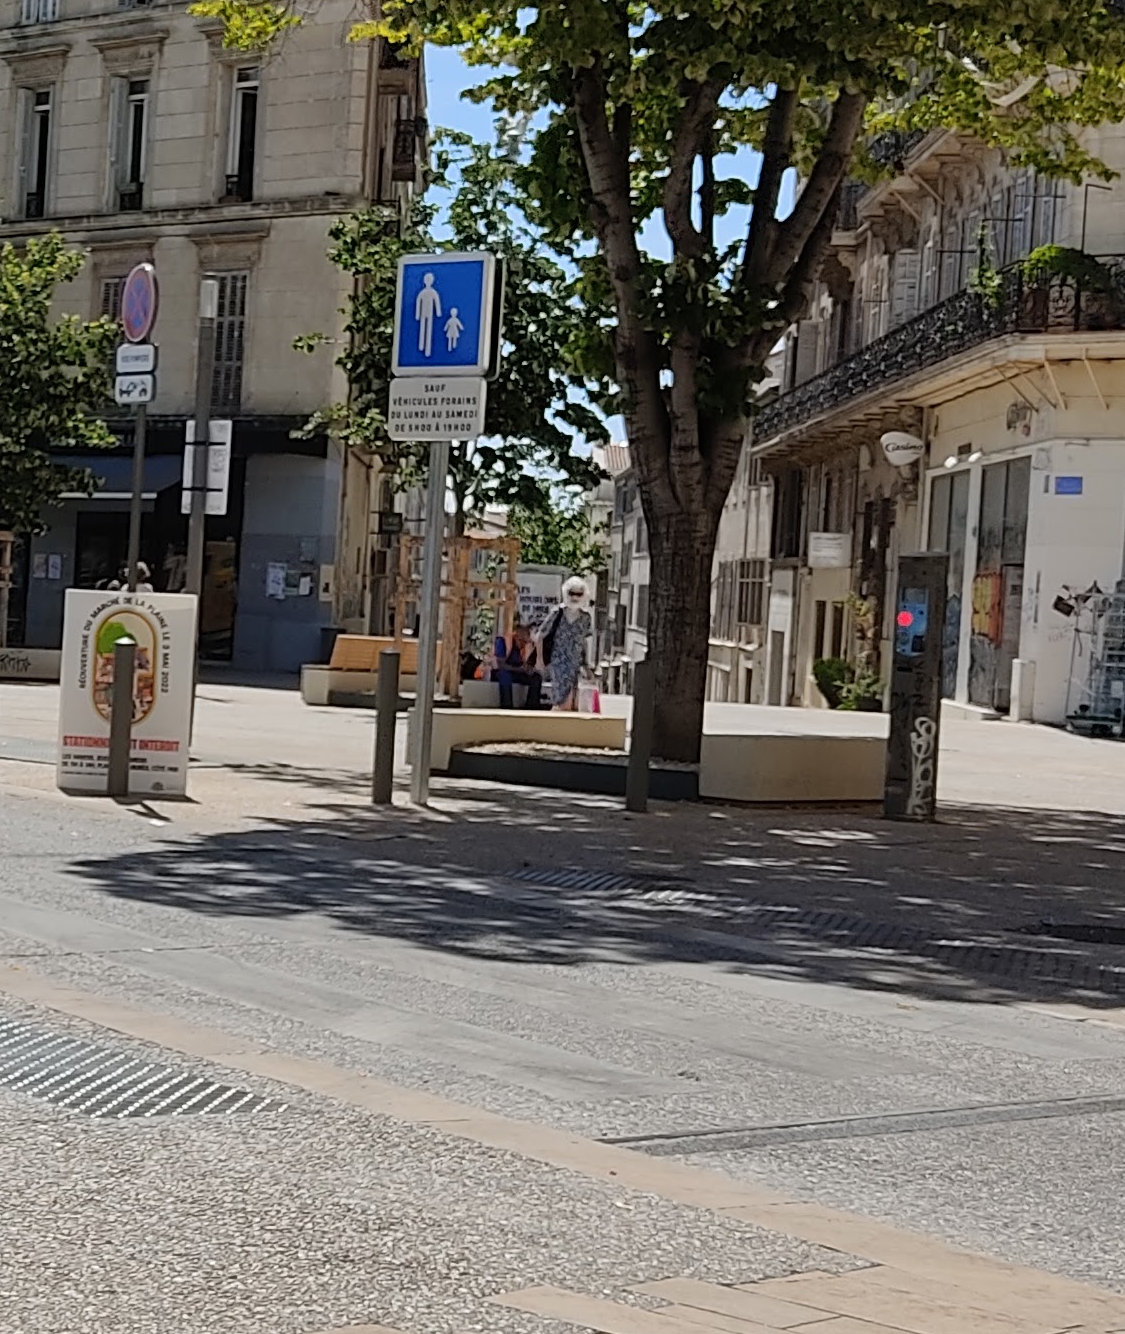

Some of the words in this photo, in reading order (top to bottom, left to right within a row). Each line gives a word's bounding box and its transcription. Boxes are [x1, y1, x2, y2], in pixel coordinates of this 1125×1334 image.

[424, 384, 446, 393] SAUF
[441, 397, 477, 406] FORAINS
[391, 411, 401, 419] DU
[404, 410, 429, 419] LUNDI
[432, 410, 442, 419] AU
[445, 409, 478, 419] SAMEDI
[395, 424, 405, 432] DE
